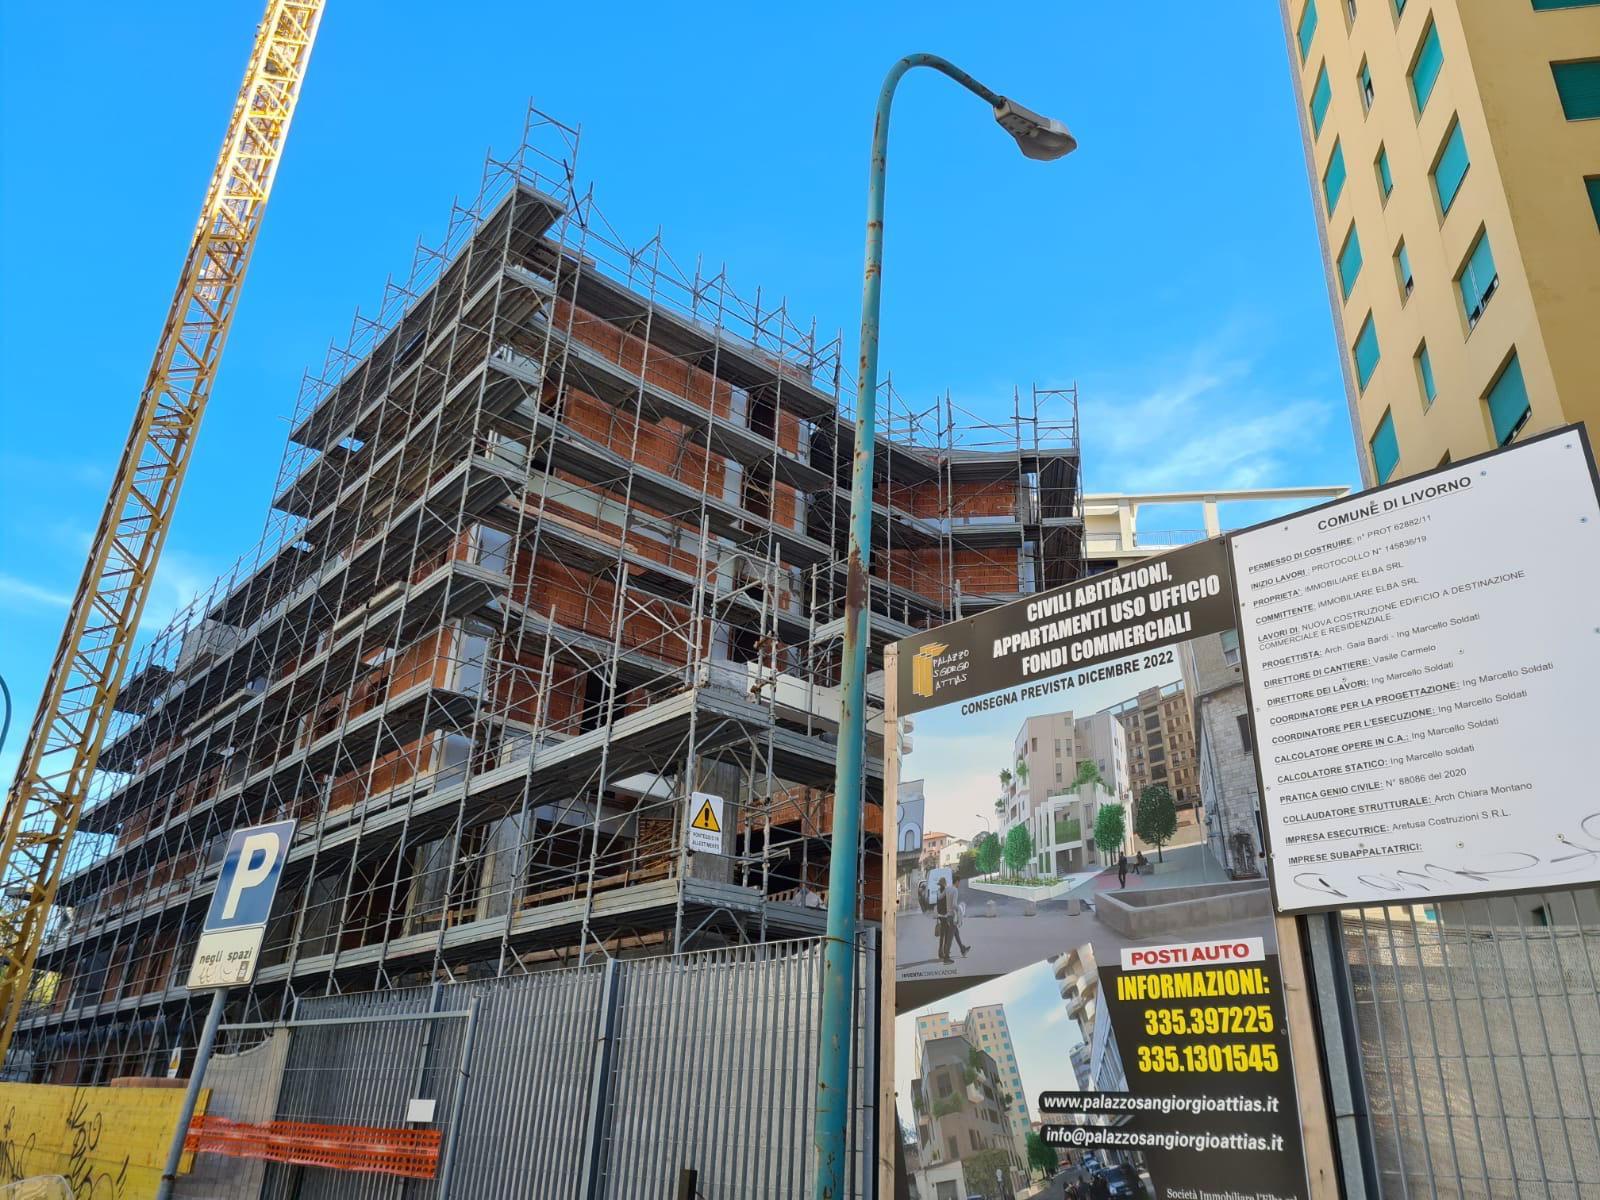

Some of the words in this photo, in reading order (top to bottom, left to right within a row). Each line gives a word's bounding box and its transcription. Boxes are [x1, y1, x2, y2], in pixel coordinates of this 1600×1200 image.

[1317, 503, 1379, 531] COMUNE
[1383, 497, 1398, 511] DI
[1401, 475, 1472, 505] LIVORNO
[1248, 554, 1292, 573] PERMESSO
[1293, 551, 1302, 560] DI
[1366, 525, 1392, 539] PROT
[1250, 577, 1273, 590] INIZIO
[1311, 550, 1370, 573] PROTOCOLLO
[1304, 572, 1359, 593] IMMOBILIARE
[1360, 565, 1384, 578] ELBA
[1385, 560, 1404, 571] SRL
[1027, 591, 1072, 622] CIVILI
[1075, 561, 1173, 607] ABITAZIONI,
[1257, 628, 1287, 642] LAVORI
[1301, 617, 1331, 631] NUOVA
[1333, 601, 1397, 623] COSTRUZIONE
[1399, 590, 1440, 607] EDIFICIO
[1441, 588, 1449, 597] A
[1450, 569, 1526, 594] DESTINAZIONE
[1317, 587, 1373, 608] IMMOBILIARE
[1375, 581, 1399, 593] ELBA
[1400, 576, 1418, 587] SRL
[993, 607, 1108, 658] APPARTAMENTI
[1111, 597, 1144, 624] USO
[1149, 574, 1220, 611] UFFICIO
[1258, 630, 1319, 651] COMMERCIALE
[1320, 628, 1327, 636] E
[1328, 612, 1392, 634] RESIDENZIALE
[933, 649, 970, 668] PALAZZO
[1022, 649, 1068, 676] FONDI
[1071, 611, 1192, 667] COMMERCIALI
[1261, 648, 1323, 669] PROGETTISTA:
[1323, 643, 1344, 655] Arch.
[1346, 638, 1366, 650] Gaia
[1366, 633, 1389, 645] Bardi
[1395, 628, 1410, 640] Ing
[1411, 619, 1448, 635] Marcello
[1449, 611, 1480, 626] Soldati
[935, 673, 968, 691] ATTIAS
[961, 694, 1018, 716] CONSEGNA
[1021, 678, 1075, 701] PREVISTA
[1078, 661, 1141, 688] DICEMBRE
[1143, 651, 1174, 668] 2022
[1263, 670, 1311, 688] DIRETTORE
[1312, 668, 1321, 677] DI
[1323, 657, 1371, 675] CANTIERE:
[1372, 651, 1398, 664] Vasile
[1399, 643, 1436, 658] Carmelo
[1266, 689, 1314, 706] DIRETTORE
[1319, 686, 1331, 696] DEI
[1332, 678, 1369, 693] LAVORI:
[1370, 674, 1385, 687] Ing
[1386, 666, 1422, 682] Marcello
[1423, 660, 1454, 674] Soldati
[1269, 704, 1338, 725] COORDINATORE
[1339, 700, 1359, 711] PER
[1360, 697, 1373, 707] LA
[1374, 680, 1460, 704] PROGETTAZIONE:
[1461, 676, 1477, 689] Ing
[1478, 668, 1519, 684] Marcello
[1520, 661, 1554, 676] Soldati
[1271, 724, 1341, 744] COORDINATORE
[1342, 720, 1362, 731] PER
[1363, 706, 1435, 727] L'ESECUZIONE:
[1437, 703, 1453, 716] Ing
[1453, 695, 1493, 710] Marcello
[1494, 689, 1528, 703] Soldati
[1273, 745, 1339, 764] CALCOLATORE
[1340, 739, 1373, 752] OPERE
[1374, 737, 1385, 746] IN
[1410, 729, 1426, 742] Ing
[1426, 722, 1465, 737] Marcello
[1466, 716, 1499, 730] Soldati
[1276, 765, 1343, 783] CALCOLATORE
[1344, 758, 1388, 772] STATICO:
[1389, 755, 1404, 767] Ing
[1405, 748, 1443, 762] Marcello
[1444, 743, 1475, 756] soldati
[1279, 790, 1318, 803] PRATICA
[1319, 785, 1349, 797] GENIO
[1349, 780, 1384, 793] CIVILE:
[1427, 771, 1442, 781] del
[1443, 767, 1467, 779] 2020
[1282, 805, 1356, 824] COLLAUDATORE
[1357, 795, 1432, 813] STRUTTURALE:
[1433, 791, 1455, 803] Arch
[1456, 786, 1489, 799] Chiara
[1489, 780, 1533, 795] Montano
[1284, 831, 1326, 845] IMPRESA
[1326, 823, 1390, 839] ESECUTRICE:
[1391, 818, 1426, 831] Aretusa
[1427, 811, 1480, 826] Costruzioni
[1287, 852, 1328, 865] IMPRESE
[1329, 841, 1422, 860] SUBAPPALTATRICI:
[221, 831, 280, 920] P
[200, 950, 223, 966] negli
[227, 947, 253, 963] spazi
[1131, 949, 1187, 966] POSTI
[1191, 943, 1249, 961] AUTO
[1117, 968, 1270, 1000] INFORMAZIONI:
[1145, 1005, 1274, 1036] 335.397225
[1138, 1044, 1278, 1072] 335.1301545
[1044, 1094, 1280, 1114] www.palazzosangiorgioattias.it
[1046, 1128, 1284, 1151] info@palazzosangiorgioattias.it
[1166, 1187, 1198, 1200] Società
